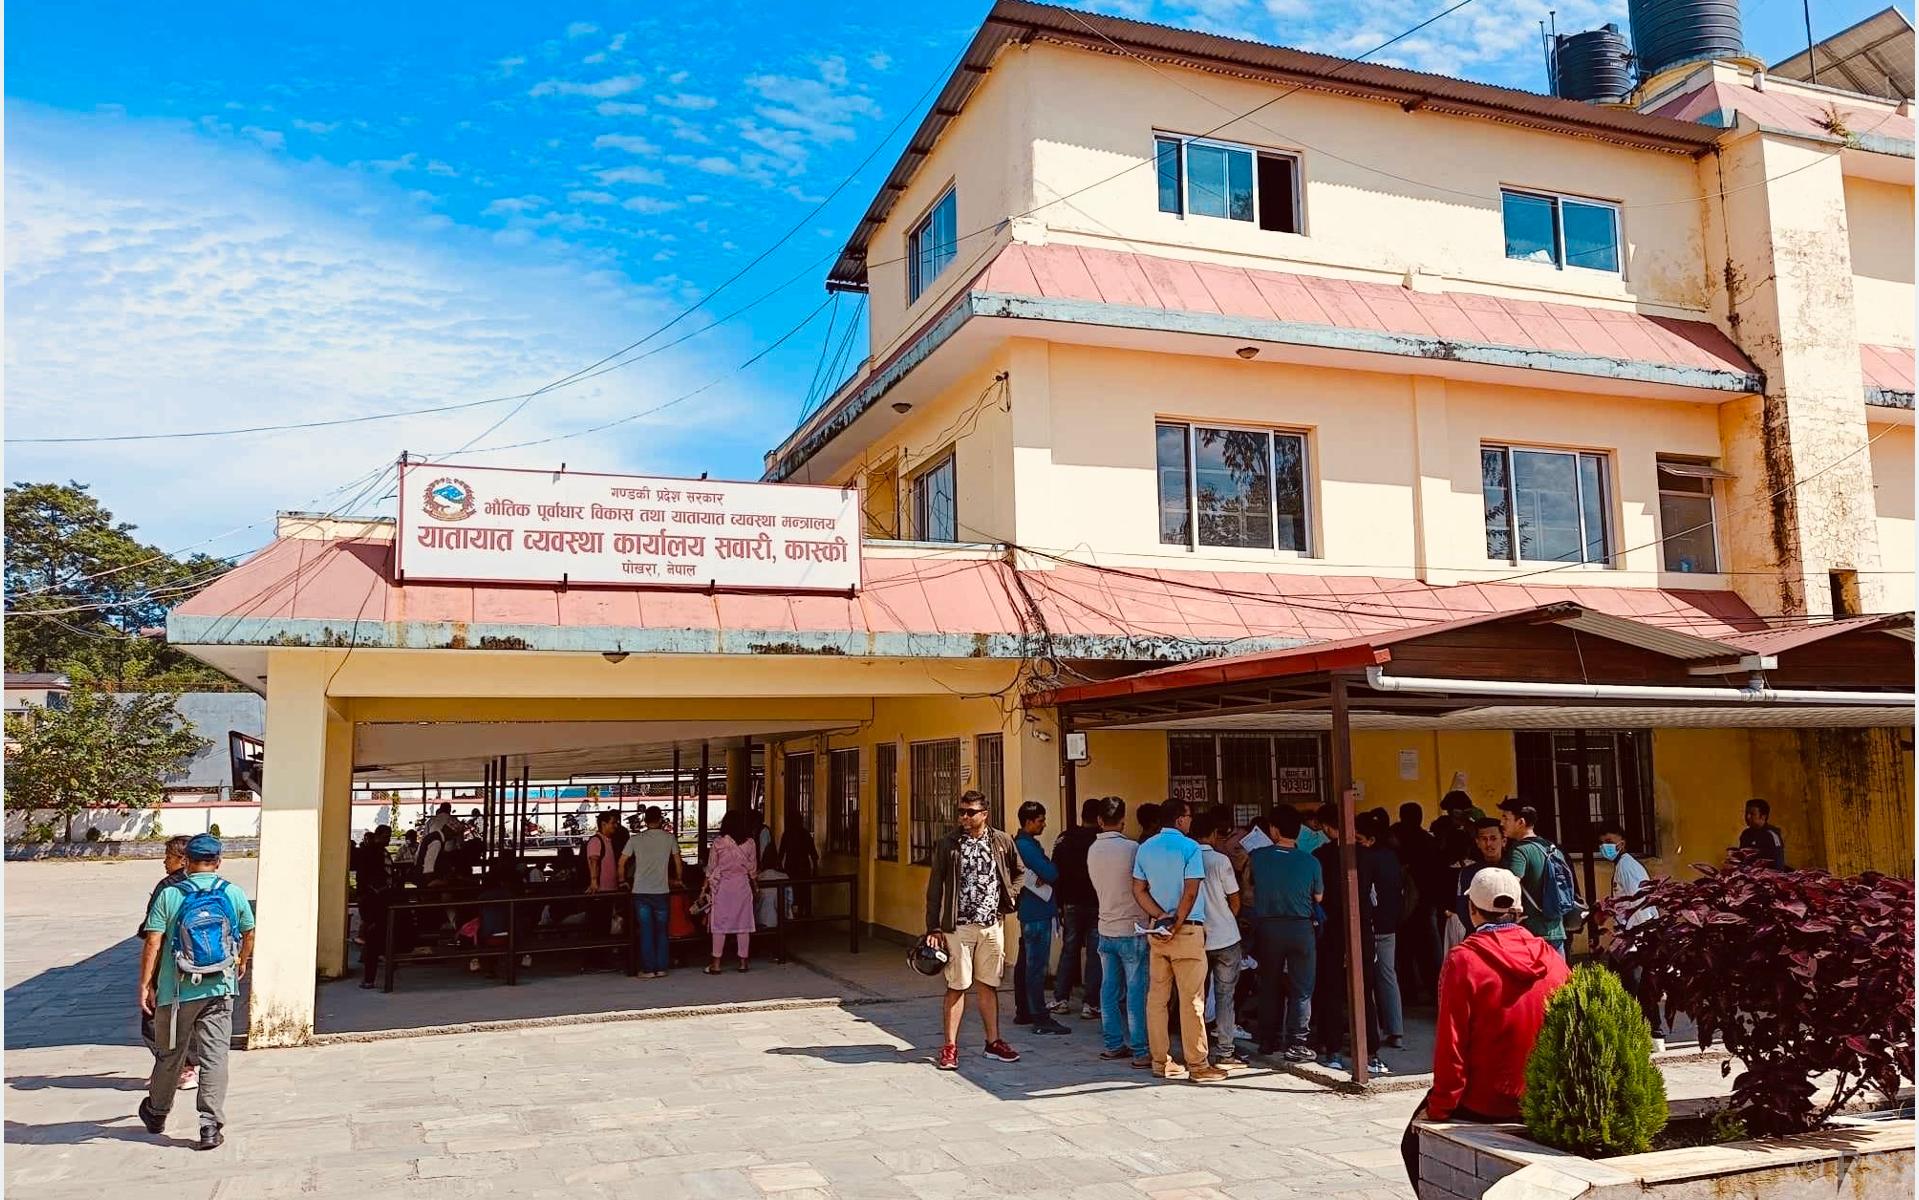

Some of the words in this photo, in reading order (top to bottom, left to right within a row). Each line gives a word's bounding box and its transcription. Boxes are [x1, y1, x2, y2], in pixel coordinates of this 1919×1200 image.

[611, 487, 650, 500] गण्डकी
[656, 489, 681, 503] प्रदेश
[686, 491, 724, 506] सरकार
[484, 499, 531, 516] भौतिक
[537, 501, 585, 521] पूर्वाधार
[591, 503, 634, 521] विकास
[640, 509, 665, 522] तथा
[672, 510, 725, 525] यातायात
[730, 513, 776, 527] व्यवस्था
[781, 516, 836, 530] मन्त्रालय
[418, 526, 514, 551] यातायात
[523, 530, 604, 554] व्यवस्था
[613, 528, 706, 557] कार्यालय
[715, 532, 777, 563] सवारी,
[785, 535, 848, 562] कास्की
[667, 561, 696, 576] नेपाल
